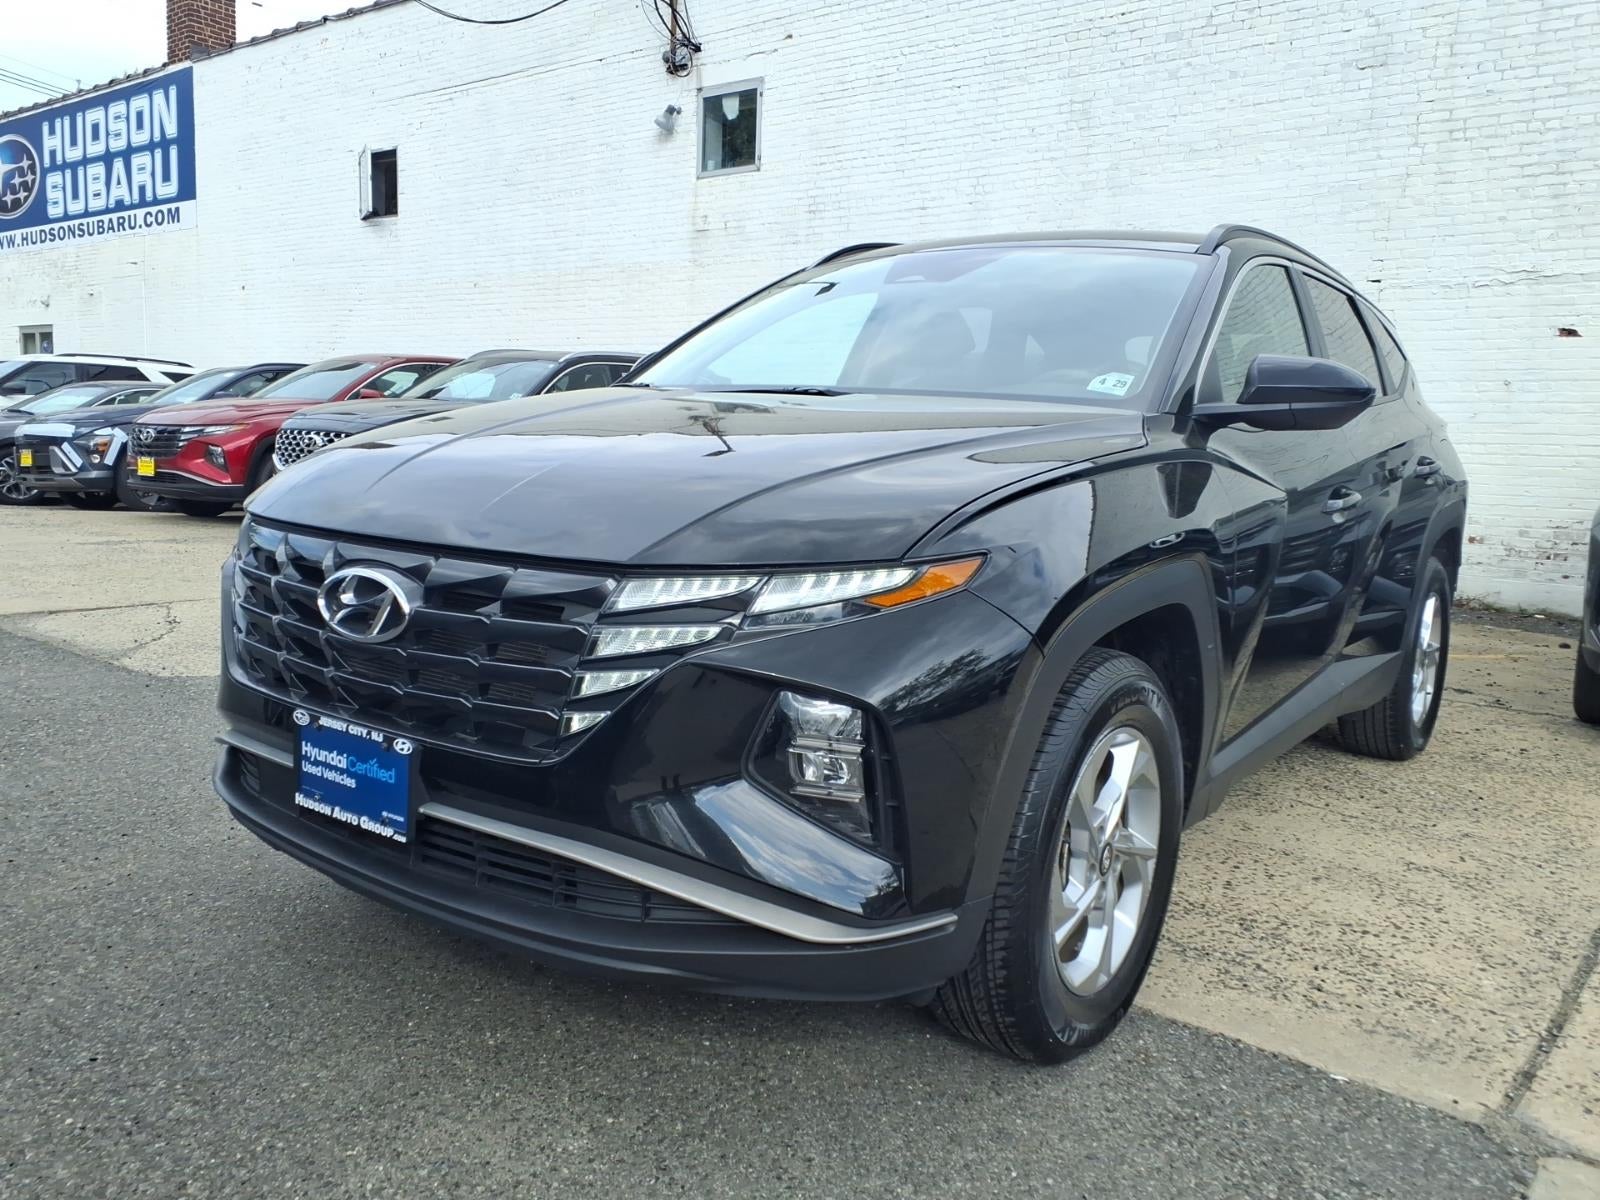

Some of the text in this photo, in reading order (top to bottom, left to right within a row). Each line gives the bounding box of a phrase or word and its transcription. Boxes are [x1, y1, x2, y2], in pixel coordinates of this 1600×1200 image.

[42, 84, 178, 168] HUDSON
[45, 144, 179, 219] SUBARU
[1111, 379, 1128, 389] 29
[319, 715, 384, 743] JERSEY CITY, NJ
[301, 740, 395, 784] Hyundai Certified
[301, 760, 357, 789] Used Vehicles
